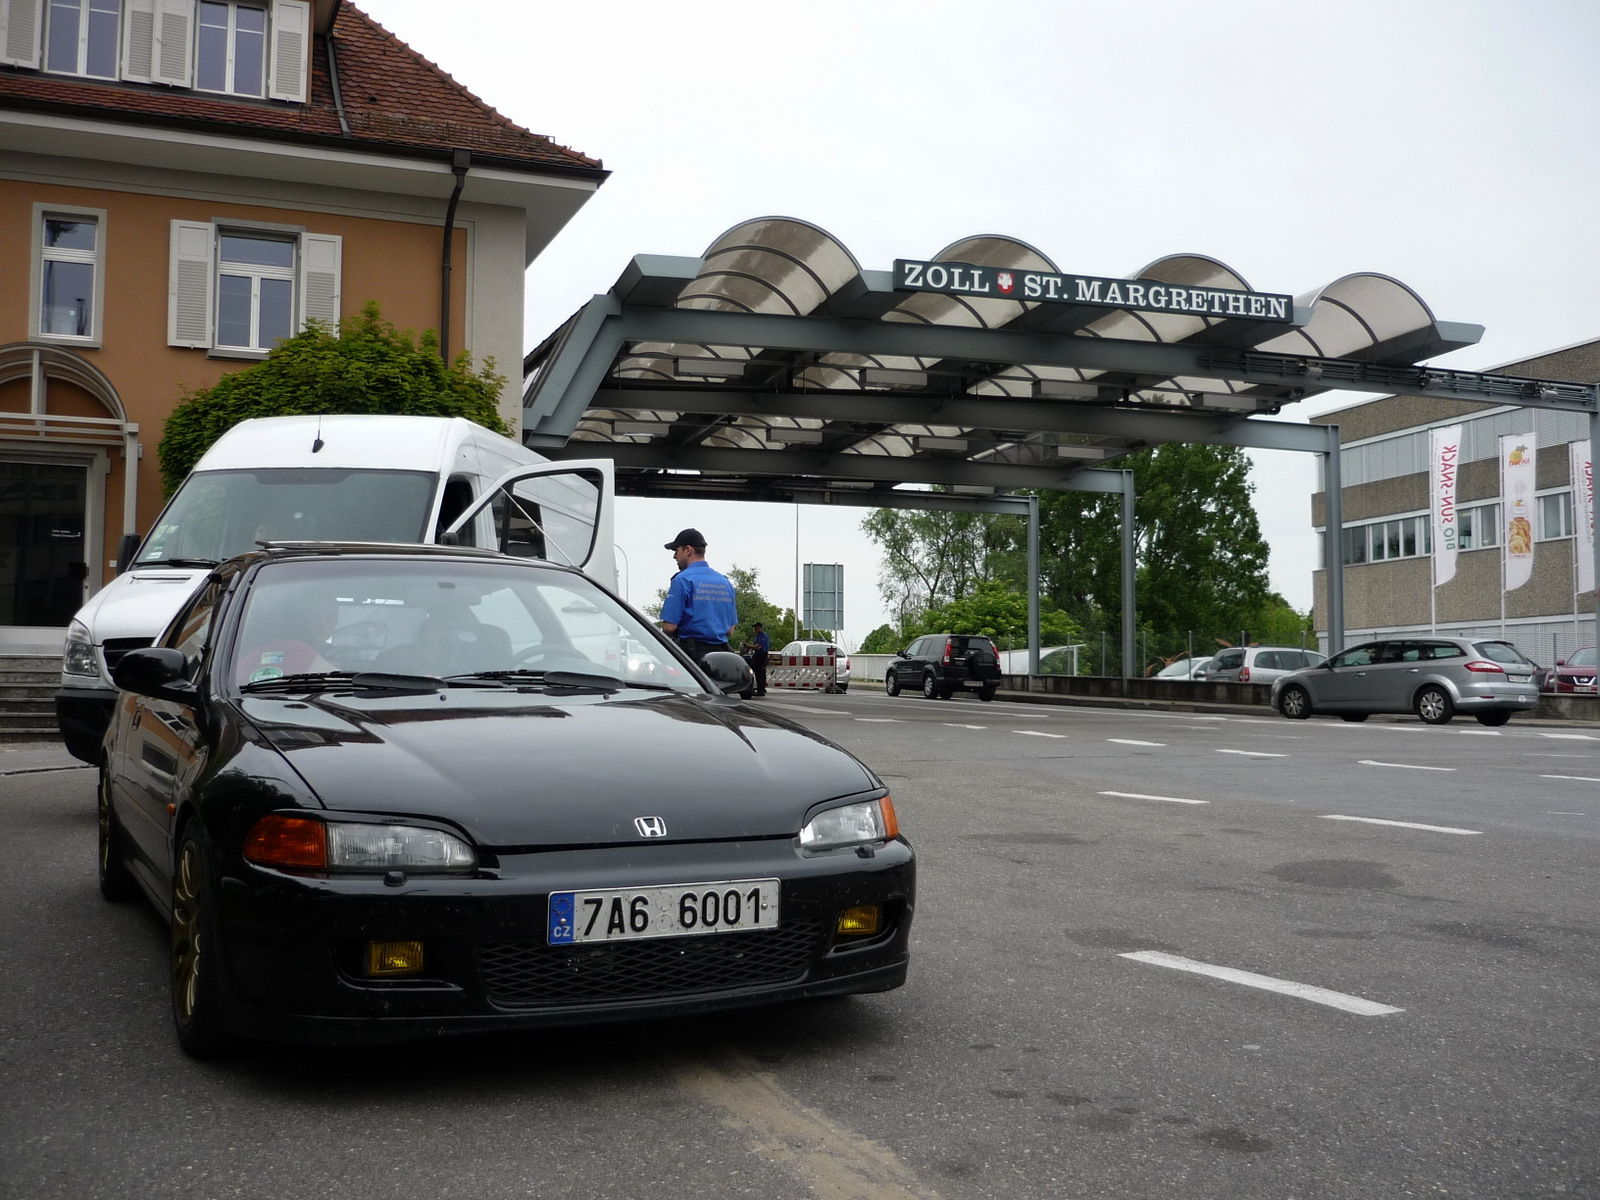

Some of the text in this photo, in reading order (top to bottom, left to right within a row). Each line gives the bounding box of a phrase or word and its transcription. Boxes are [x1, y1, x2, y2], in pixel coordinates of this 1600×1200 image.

[904, 263, 1288, 319] ZOLL ST. MARGRETHEN
[553, 925, 571, 938] CZ
[583, 887, 761, 936] 7A6 6001
